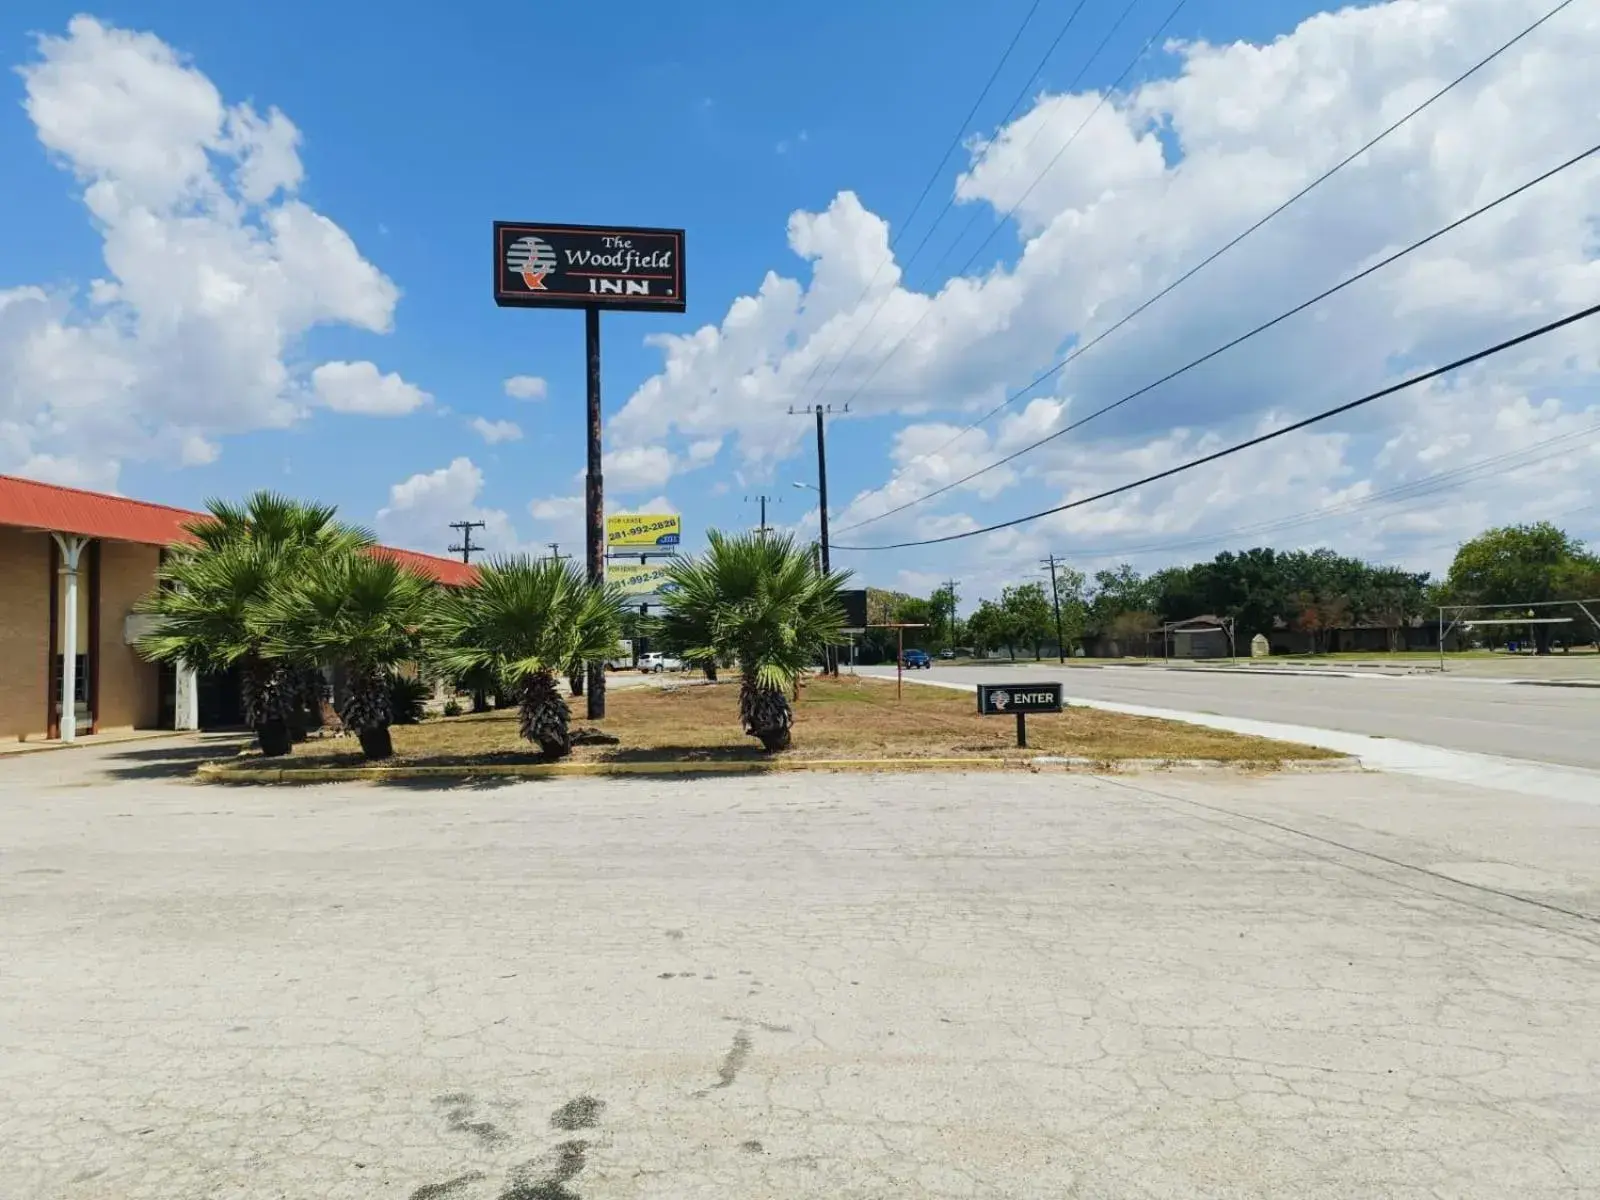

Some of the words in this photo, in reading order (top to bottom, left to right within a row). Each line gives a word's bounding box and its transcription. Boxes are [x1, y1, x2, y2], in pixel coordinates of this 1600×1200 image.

[602, 236, 632, 249] The
[564, 250, 672, 273] Woodfield
[589, 278, 649, 295] INN
[1014, 693, 1054, 704] ENTER
